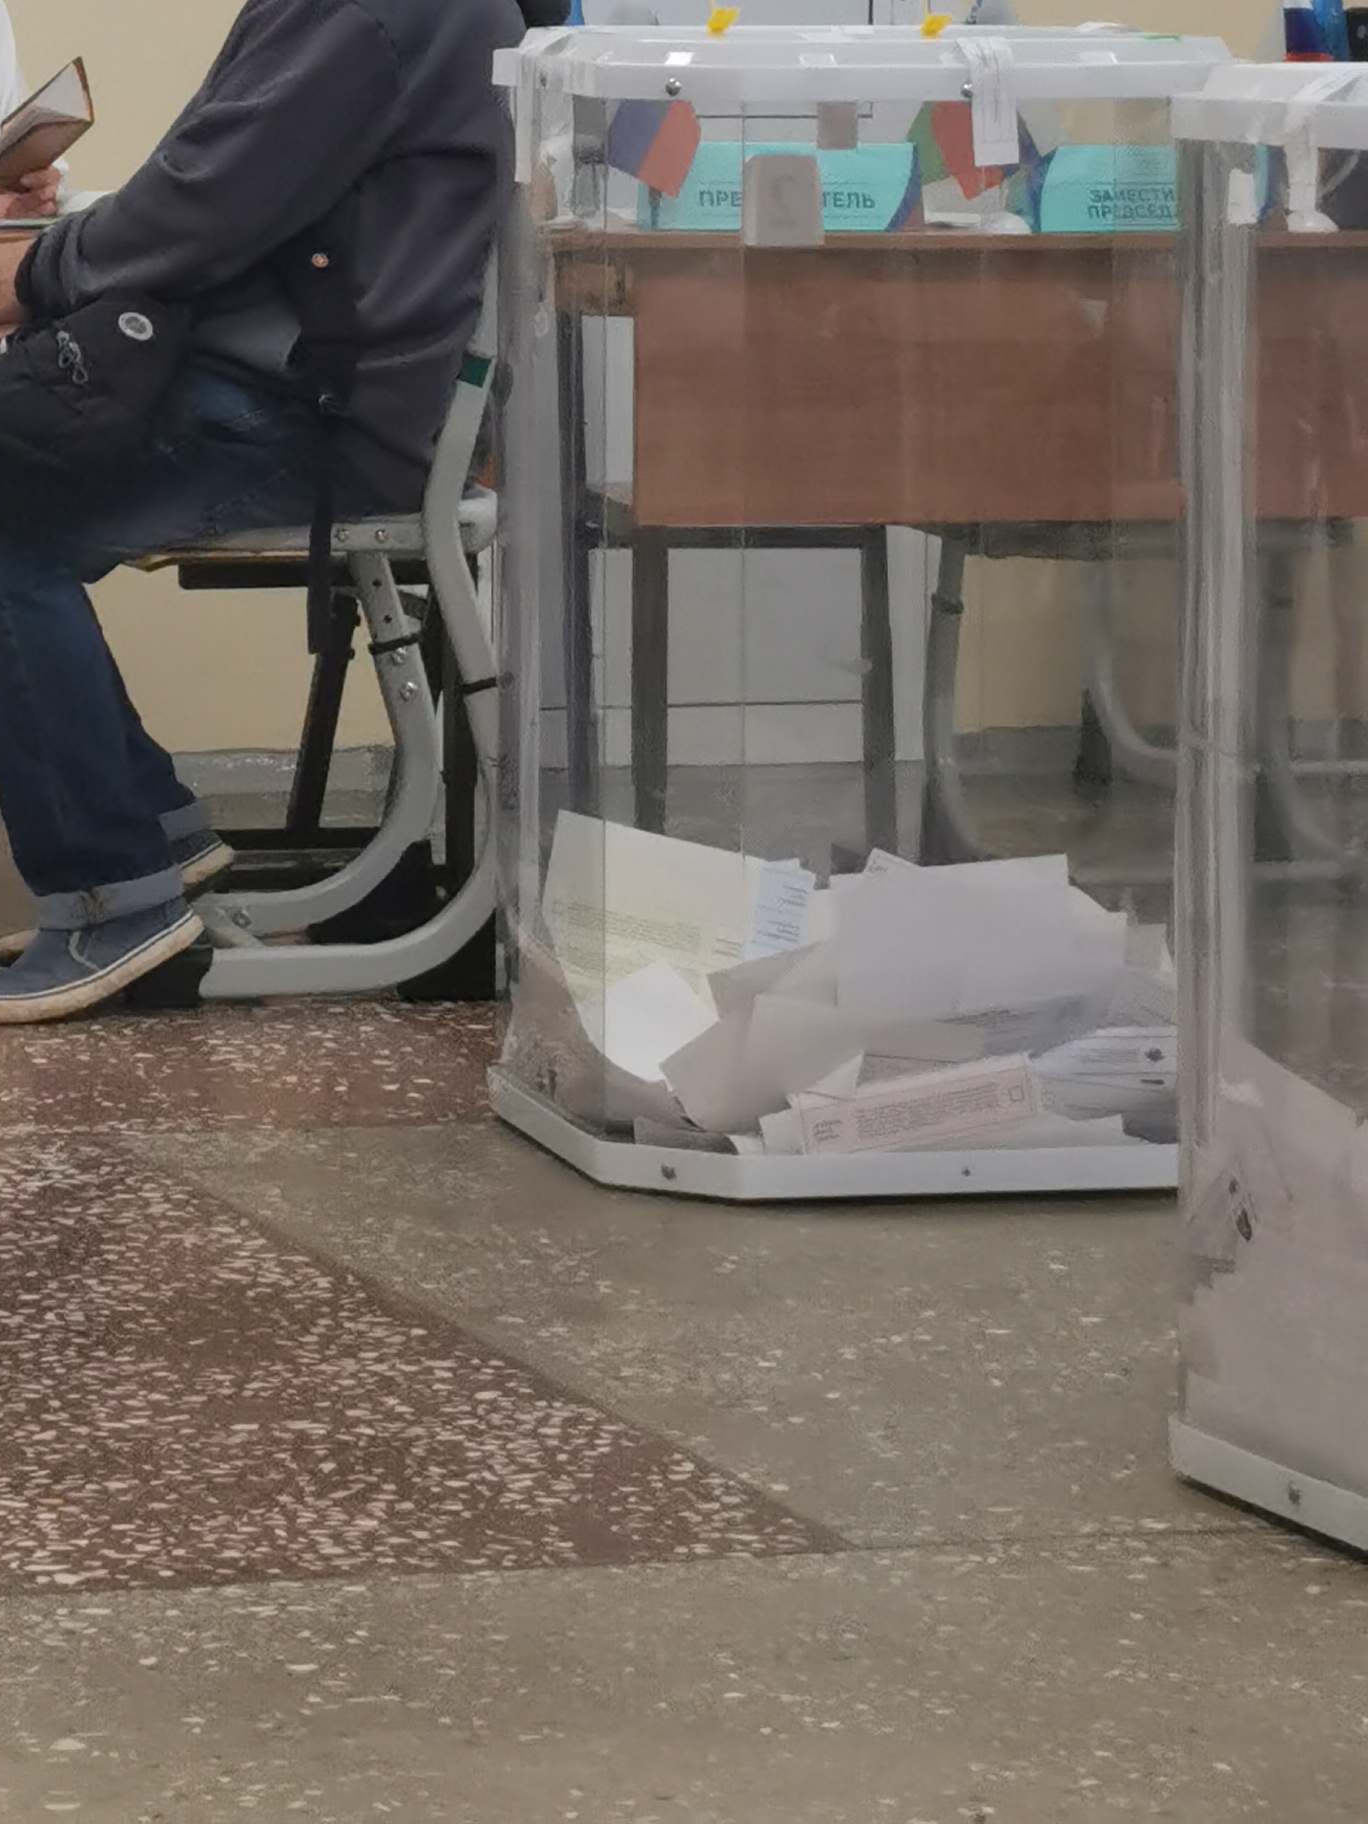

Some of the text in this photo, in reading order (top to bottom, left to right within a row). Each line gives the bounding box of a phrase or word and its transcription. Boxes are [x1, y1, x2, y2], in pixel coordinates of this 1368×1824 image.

[699, 189, 875, 210] ПРЕТЕЛЬ
[1088, 187, 1175, 203] ЗАМЕСТИ
[1087, 204, 1175, 220] ПРЕДСЕД
